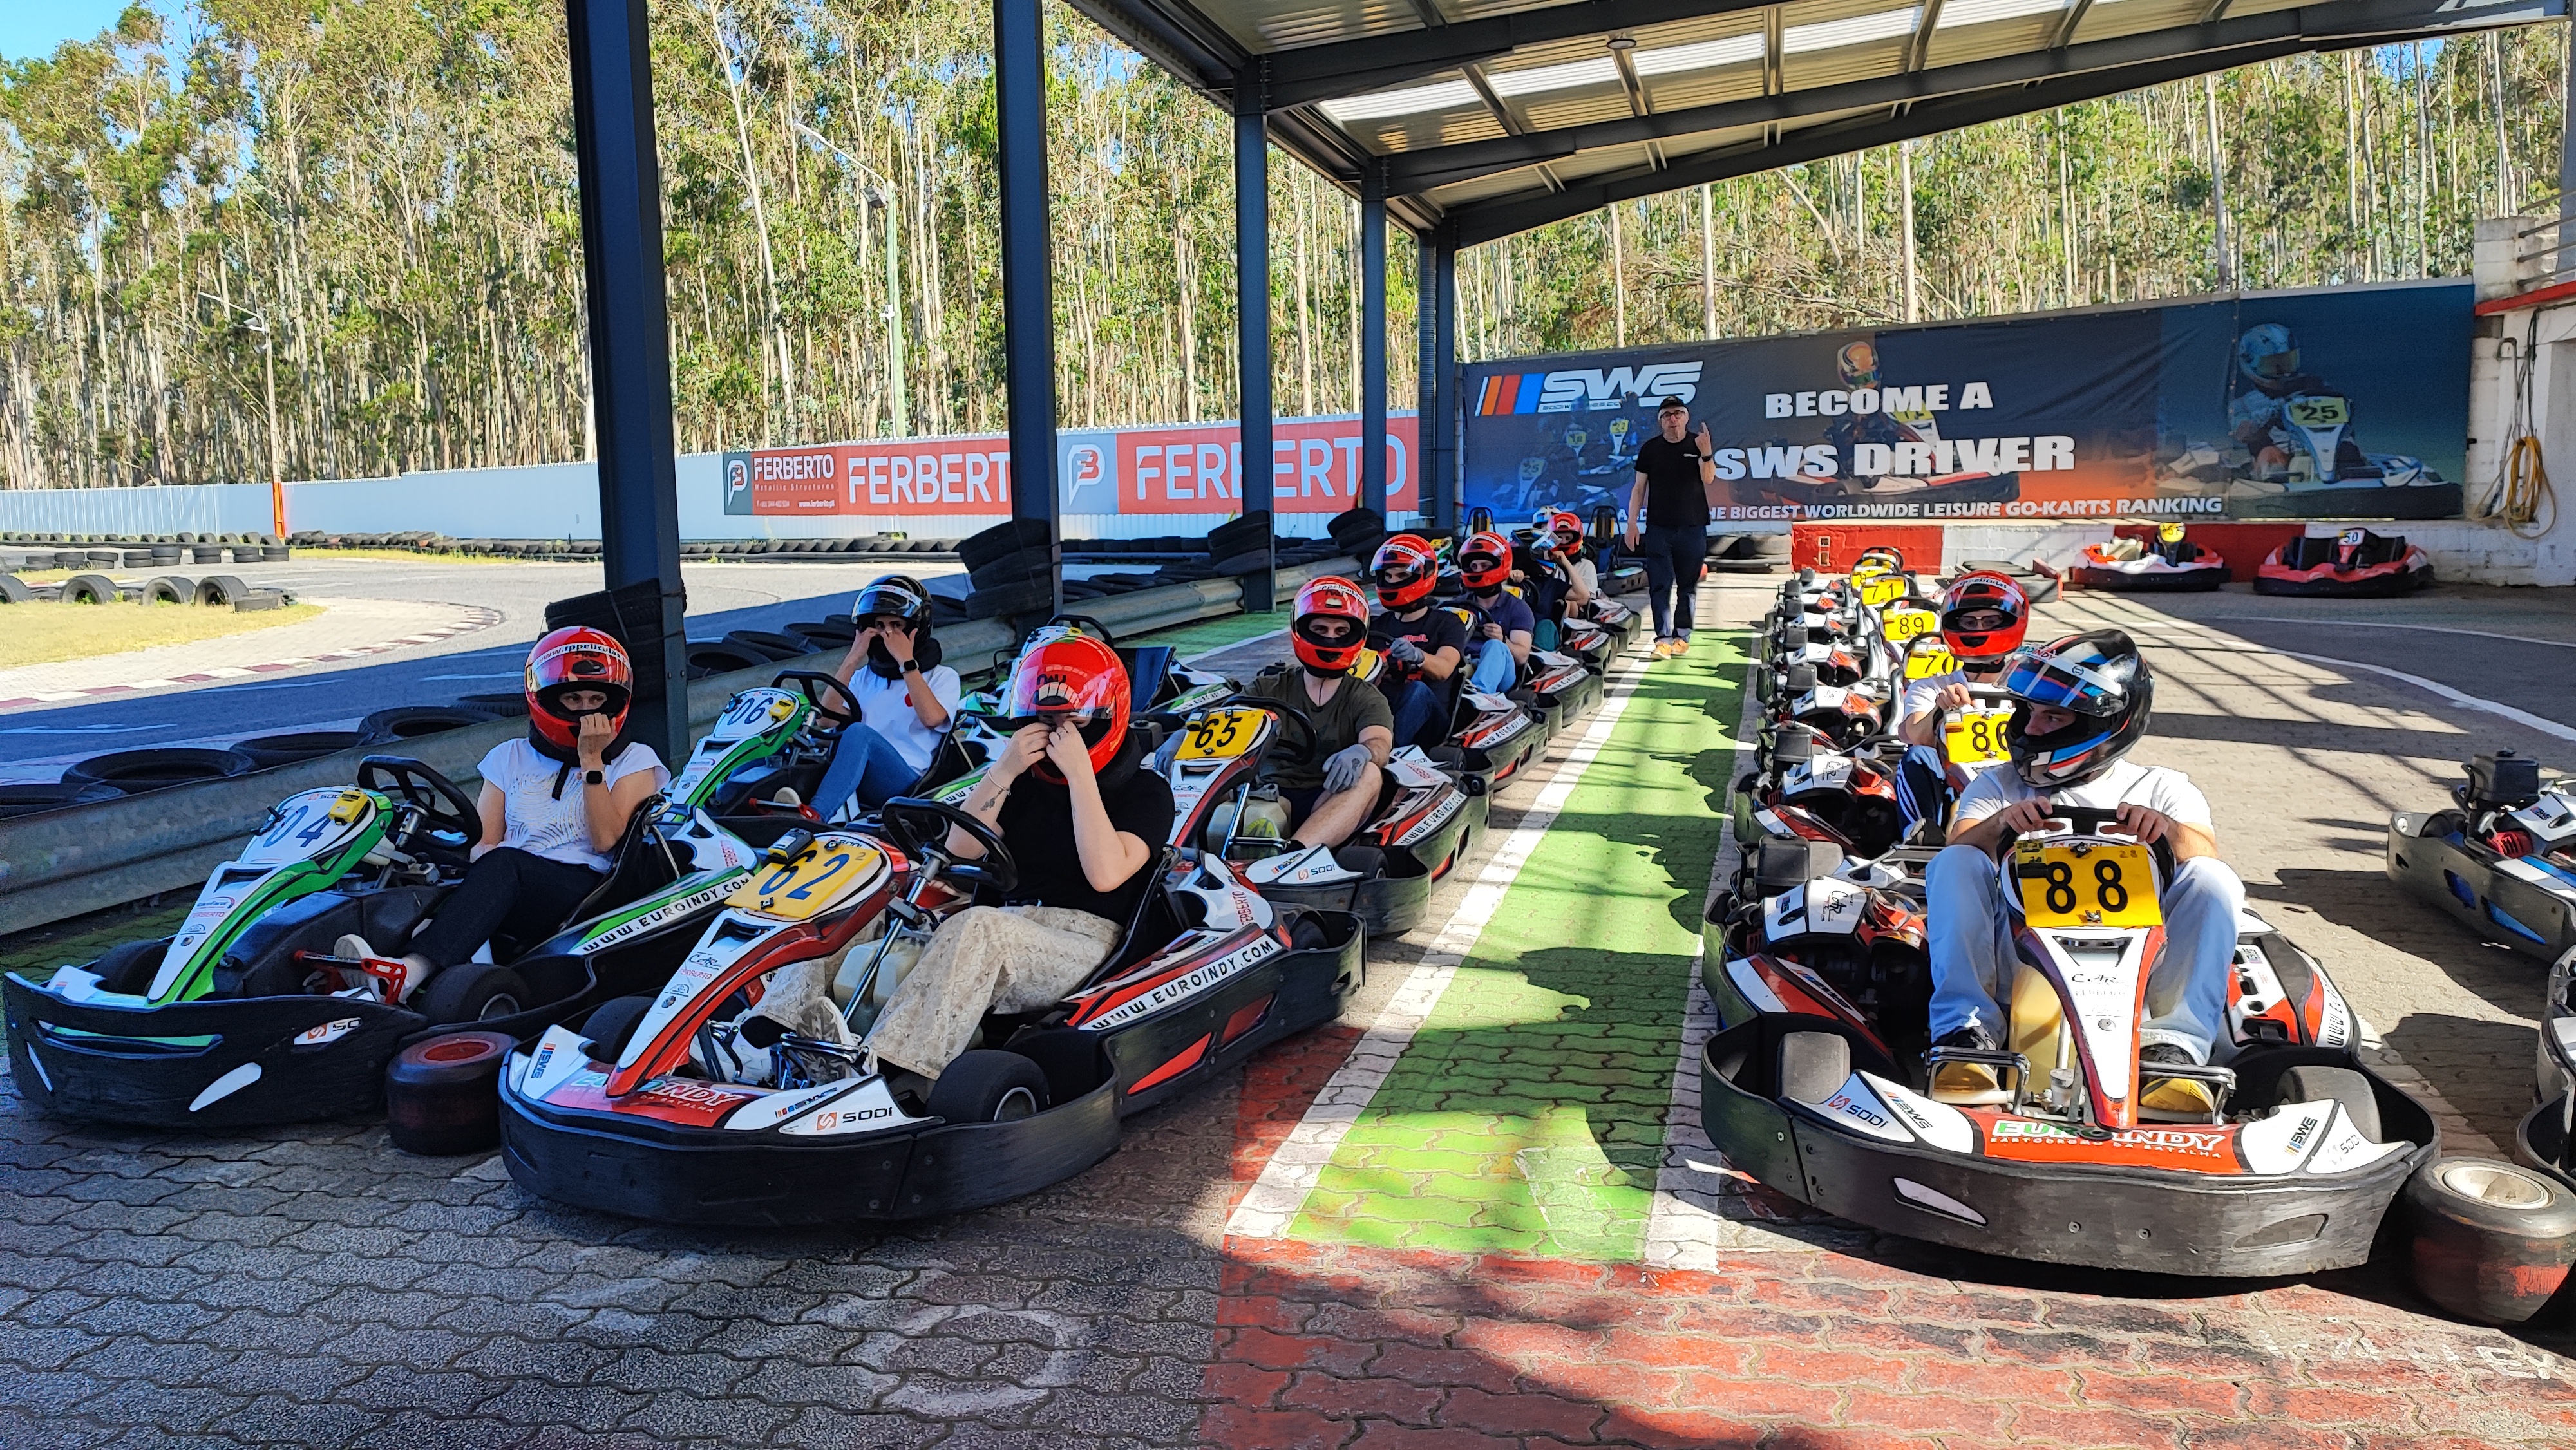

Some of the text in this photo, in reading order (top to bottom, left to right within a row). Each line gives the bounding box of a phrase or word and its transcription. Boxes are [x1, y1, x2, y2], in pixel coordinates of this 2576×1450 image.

[1539, 361, 1704, 407] SWS
[1765, 382, 1994, 419] BECOME A
[2304, 404, 2339, 421] 25
[753, 453, 835, 481] FERBERTO
[1714, 435, 2076, 480] SWS DRIVER
[848, 452, 1010, 504] FERBERT
[1710, 507, 1727, 520] HE
[1730, 505, 1801, 520] BIGGEST
[1804, 503, 1919, 519] WORLDWIDE
[1923, 502, 2002, 518] LEISURE
[2005, 499, 2111, 516] GO-KARTS
[2116, 497, 2222, 514] RANKING
[1866, 583, 1894, 600] 71
[1899, 616, 1924, 635] 89
[1924, 654, 1957, 675] 70
[726, 697, 774, 726] 06
[1195, 717, 1243, 749] 65
[263, 805, 332, 848] 04
[759, 849, 850, 901] 62
[2046, 859, 2128, 914] 88
[660, 1098, 714, 1113] BATALHA
[2143, 1144, 2222, 1158] BATALHA
